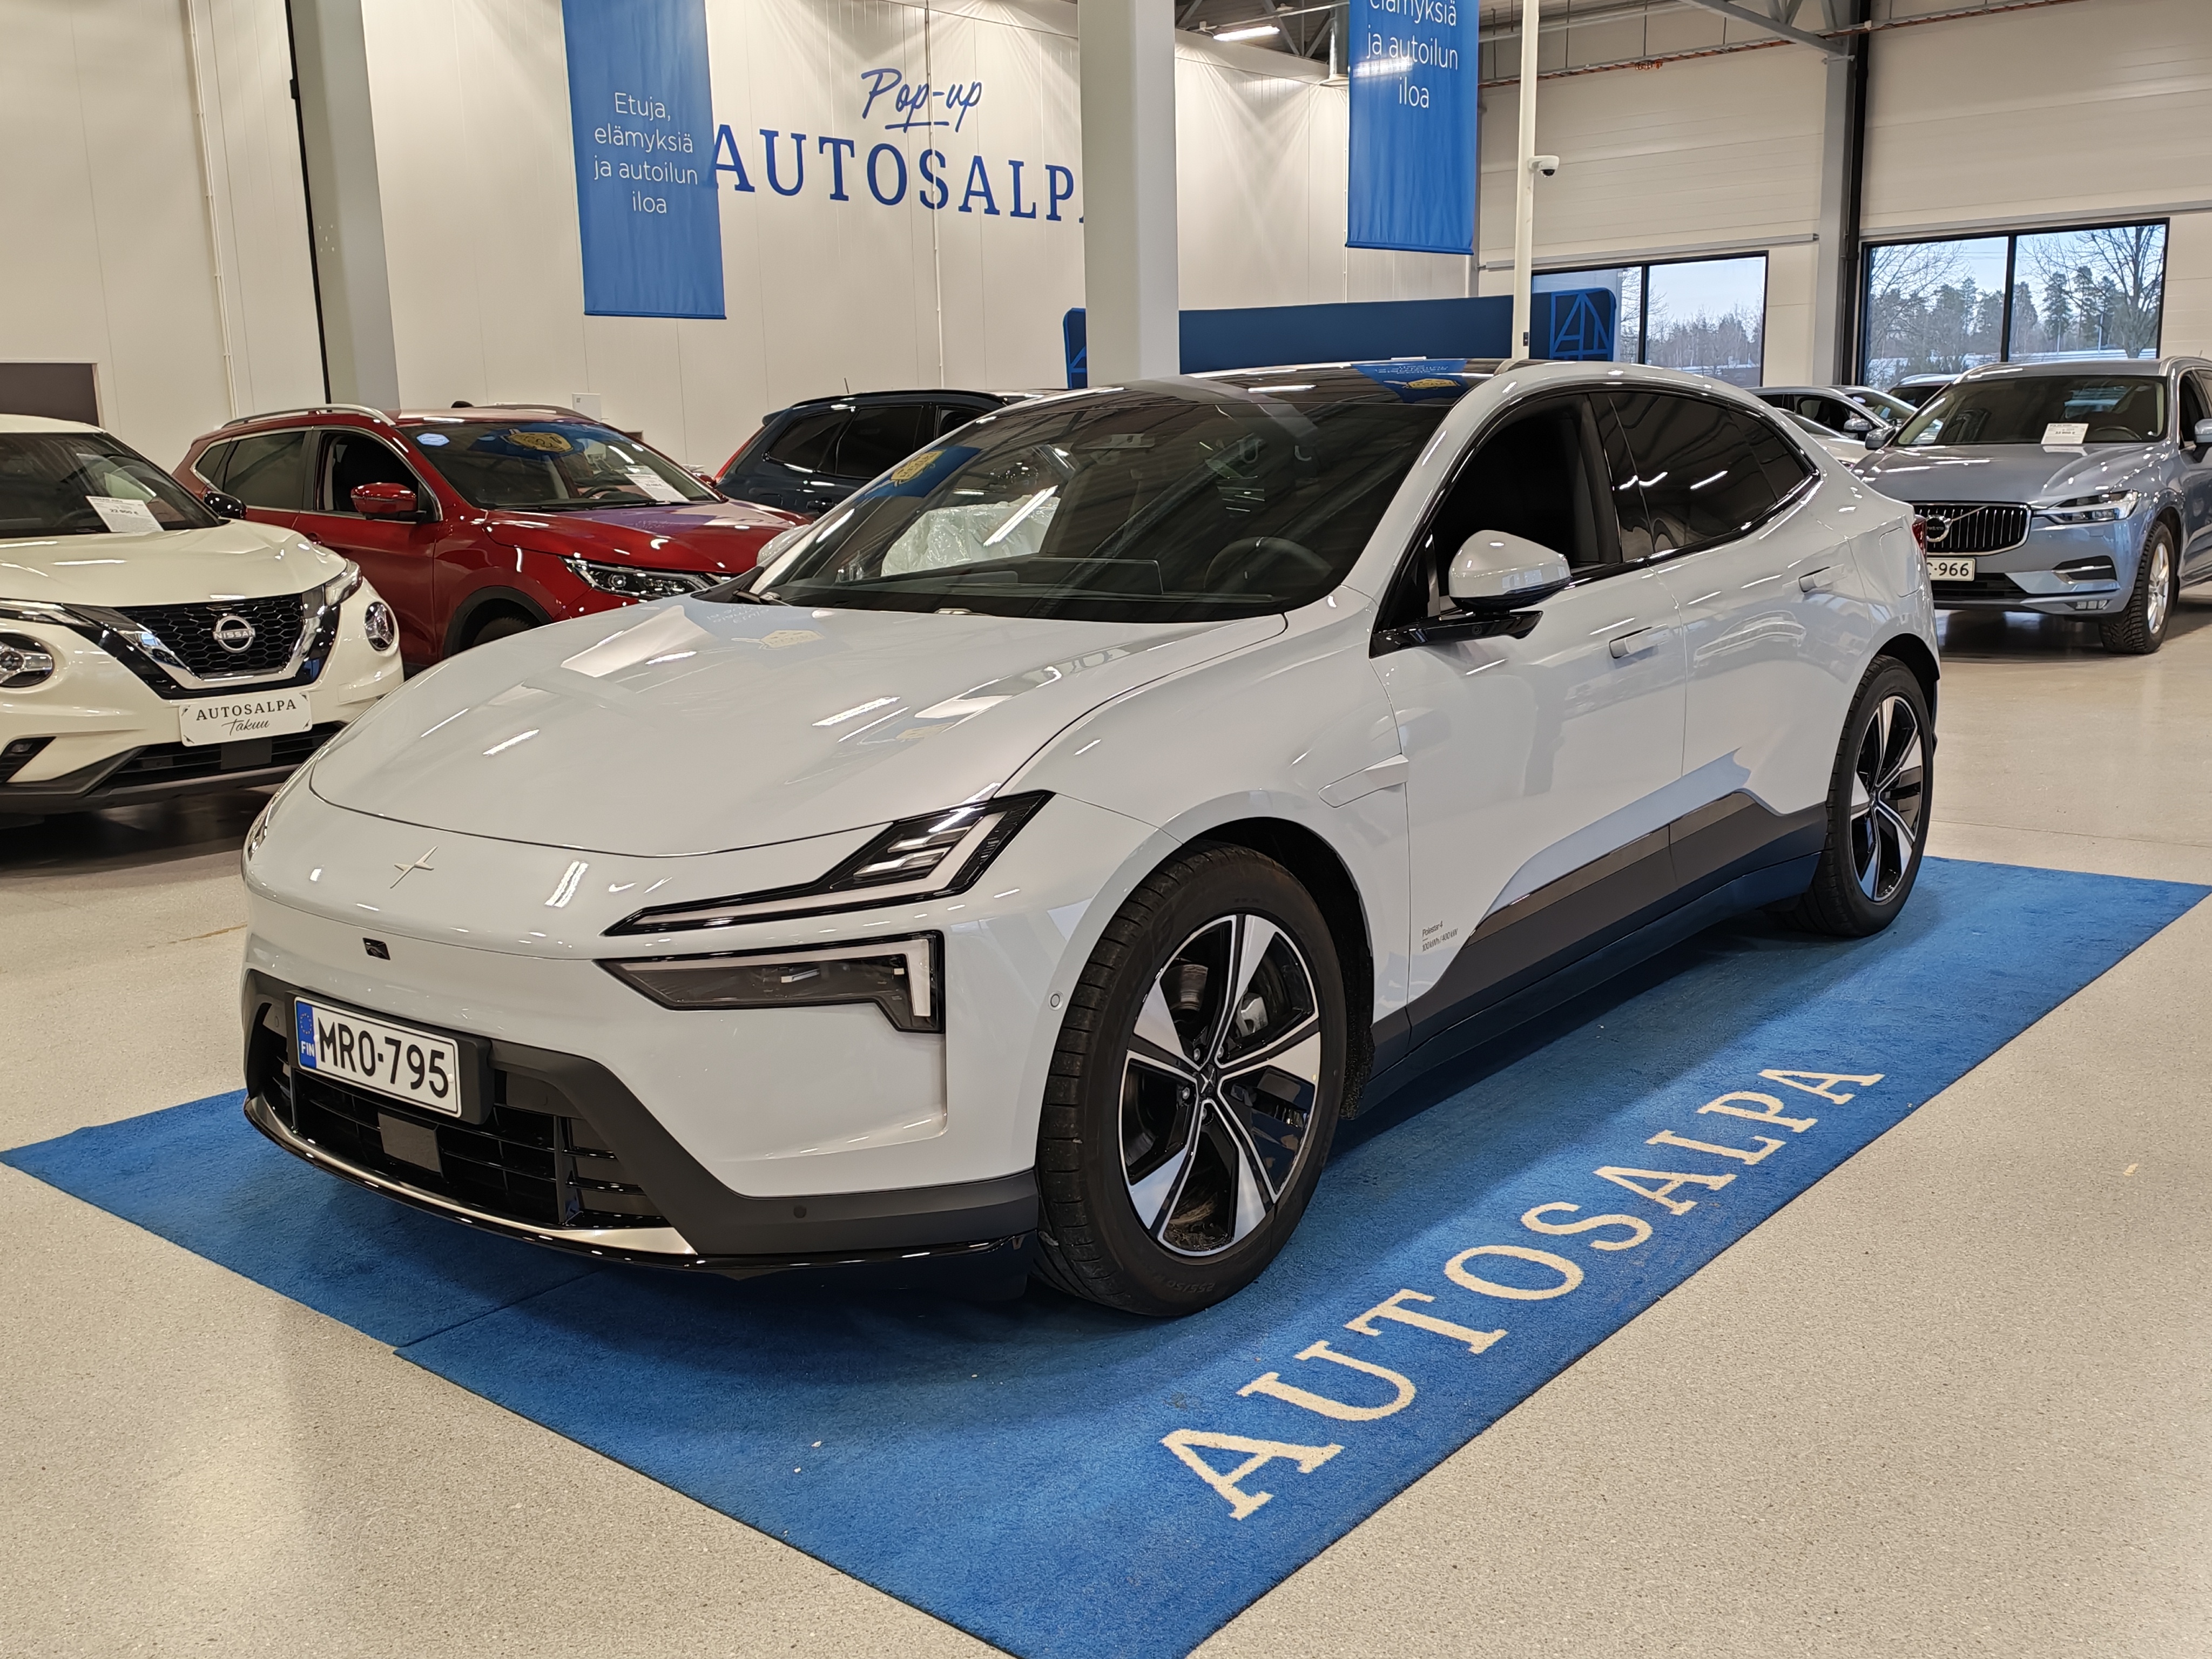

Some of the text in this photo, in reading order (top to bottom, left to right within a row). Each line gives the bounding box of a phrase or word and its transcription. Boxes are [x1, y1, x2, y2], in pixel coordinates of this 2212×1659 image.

[1366, 24, 1458, 71] ja autoilun
[615, 92, 671, 122] Etuja,
[861, 68, 982, 134] Pop-up
[1399, 76, 1429, 109] iloa
[594, 123, 693, 153] elämyksiä
[594, 154, 698, 185] ja autoilun
[706, 124, 1084, 224] AUTOSALP
[632, 191, 667, 214] iloa
[214, 628, 255, 639] NISSAN
[195, 698, 297, 721] AUTOSALPA
[221, 718, 270, 736] Takuu
[1422, 923, 1440, 938] Polestar
[301, 1041, 315, 1057] FIN
[318, 1016, 449, 1098] MRO-795
[1160, 1067, 1886, 1520] AUTOSALPA
